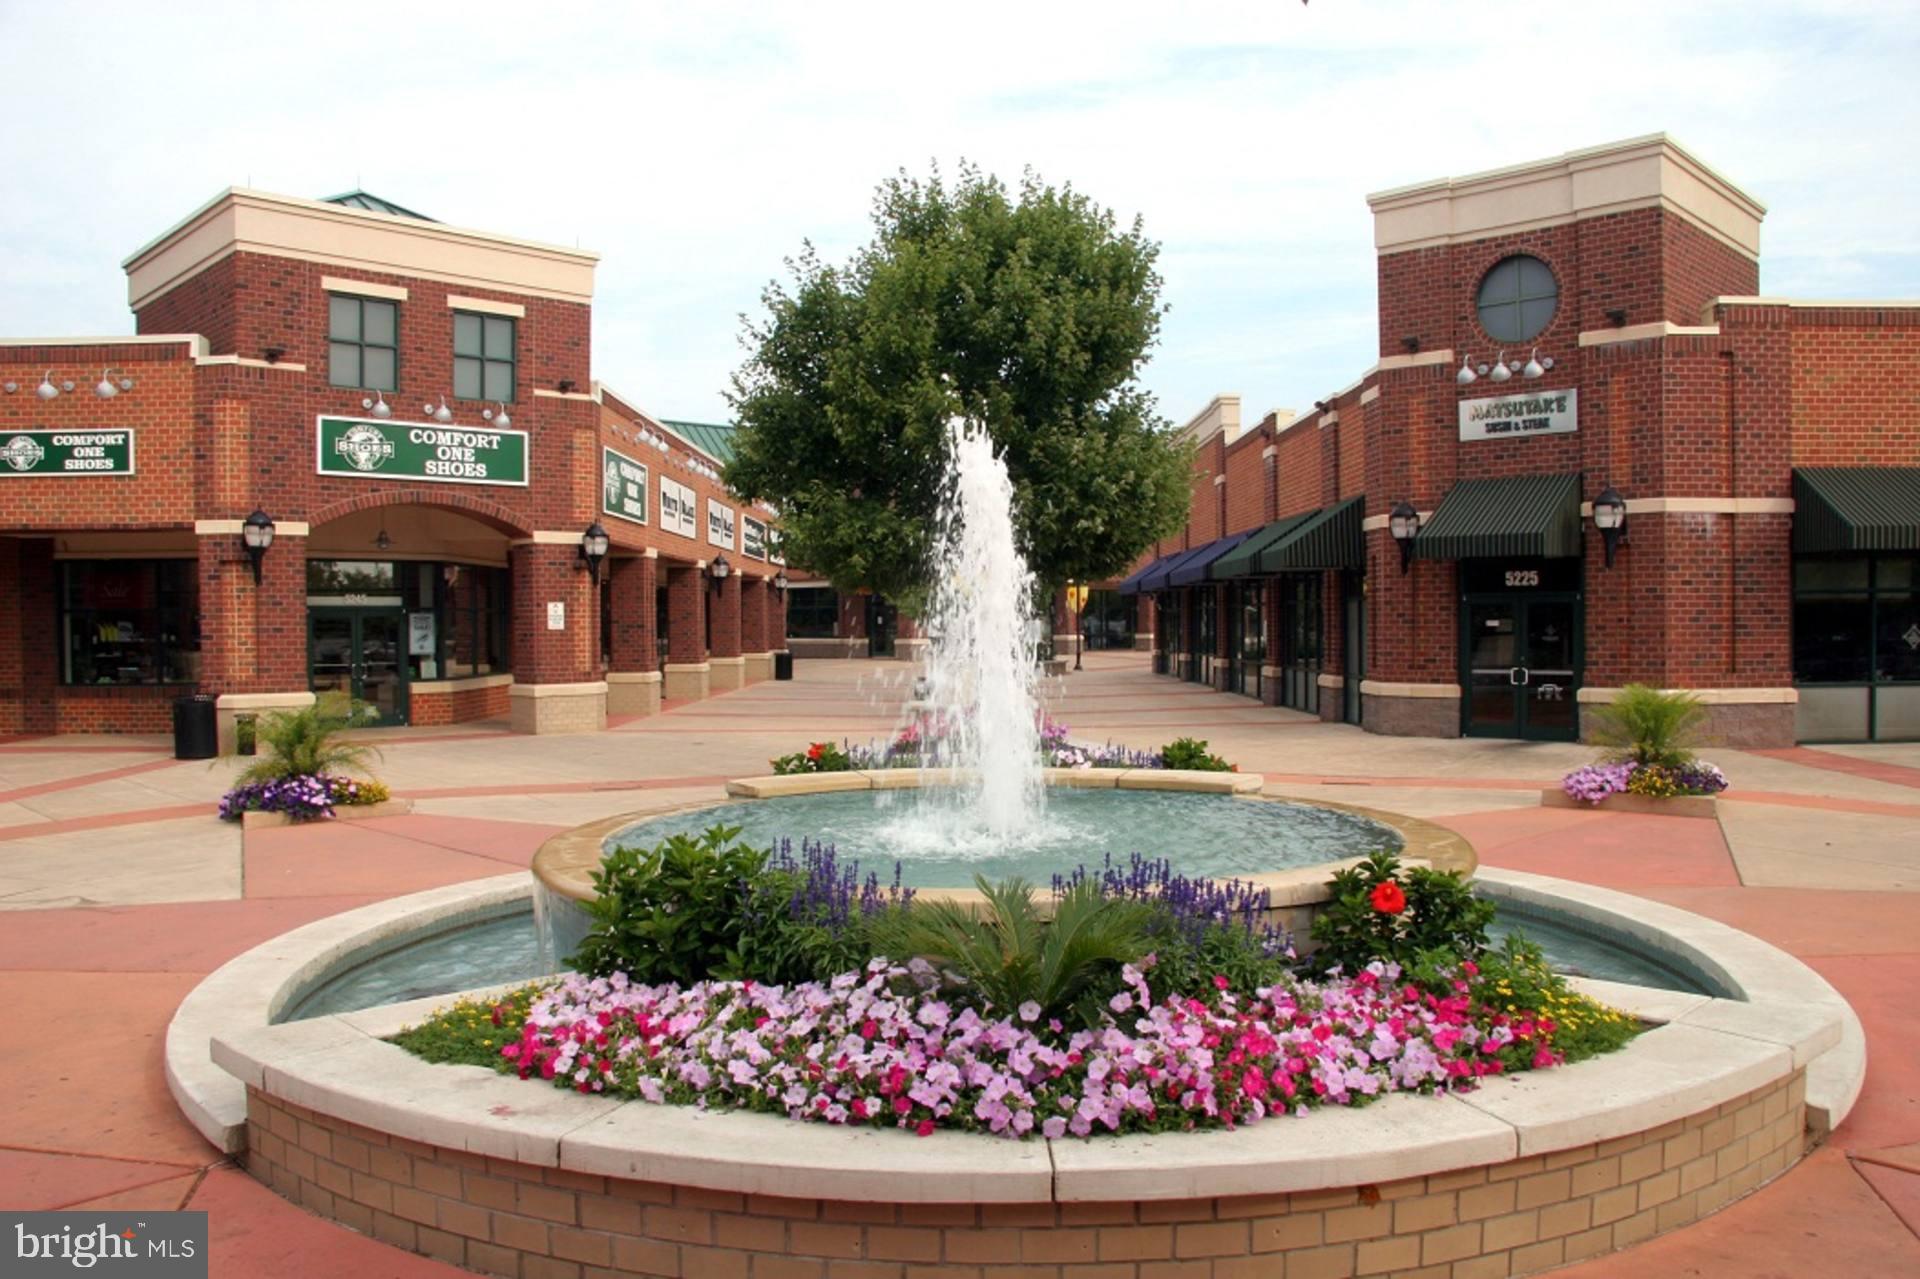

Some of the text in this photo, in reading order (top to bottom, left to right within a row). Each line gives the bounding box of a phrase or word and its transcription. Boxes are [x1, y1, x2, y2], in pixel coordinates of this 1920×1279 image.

[1513, 421, 1521, 431] &
[52, 434, 125, 446] COMFORT
[410, 428, 501, 449] COMFORT
[73, 447, 105, 457] ONE
[437, 446, 476, 462] ONE
[64, 459, 115, 469] SHOES
[425, 460, 487, 477] SHOES
[1505, 571, 1539, 586] 5225
